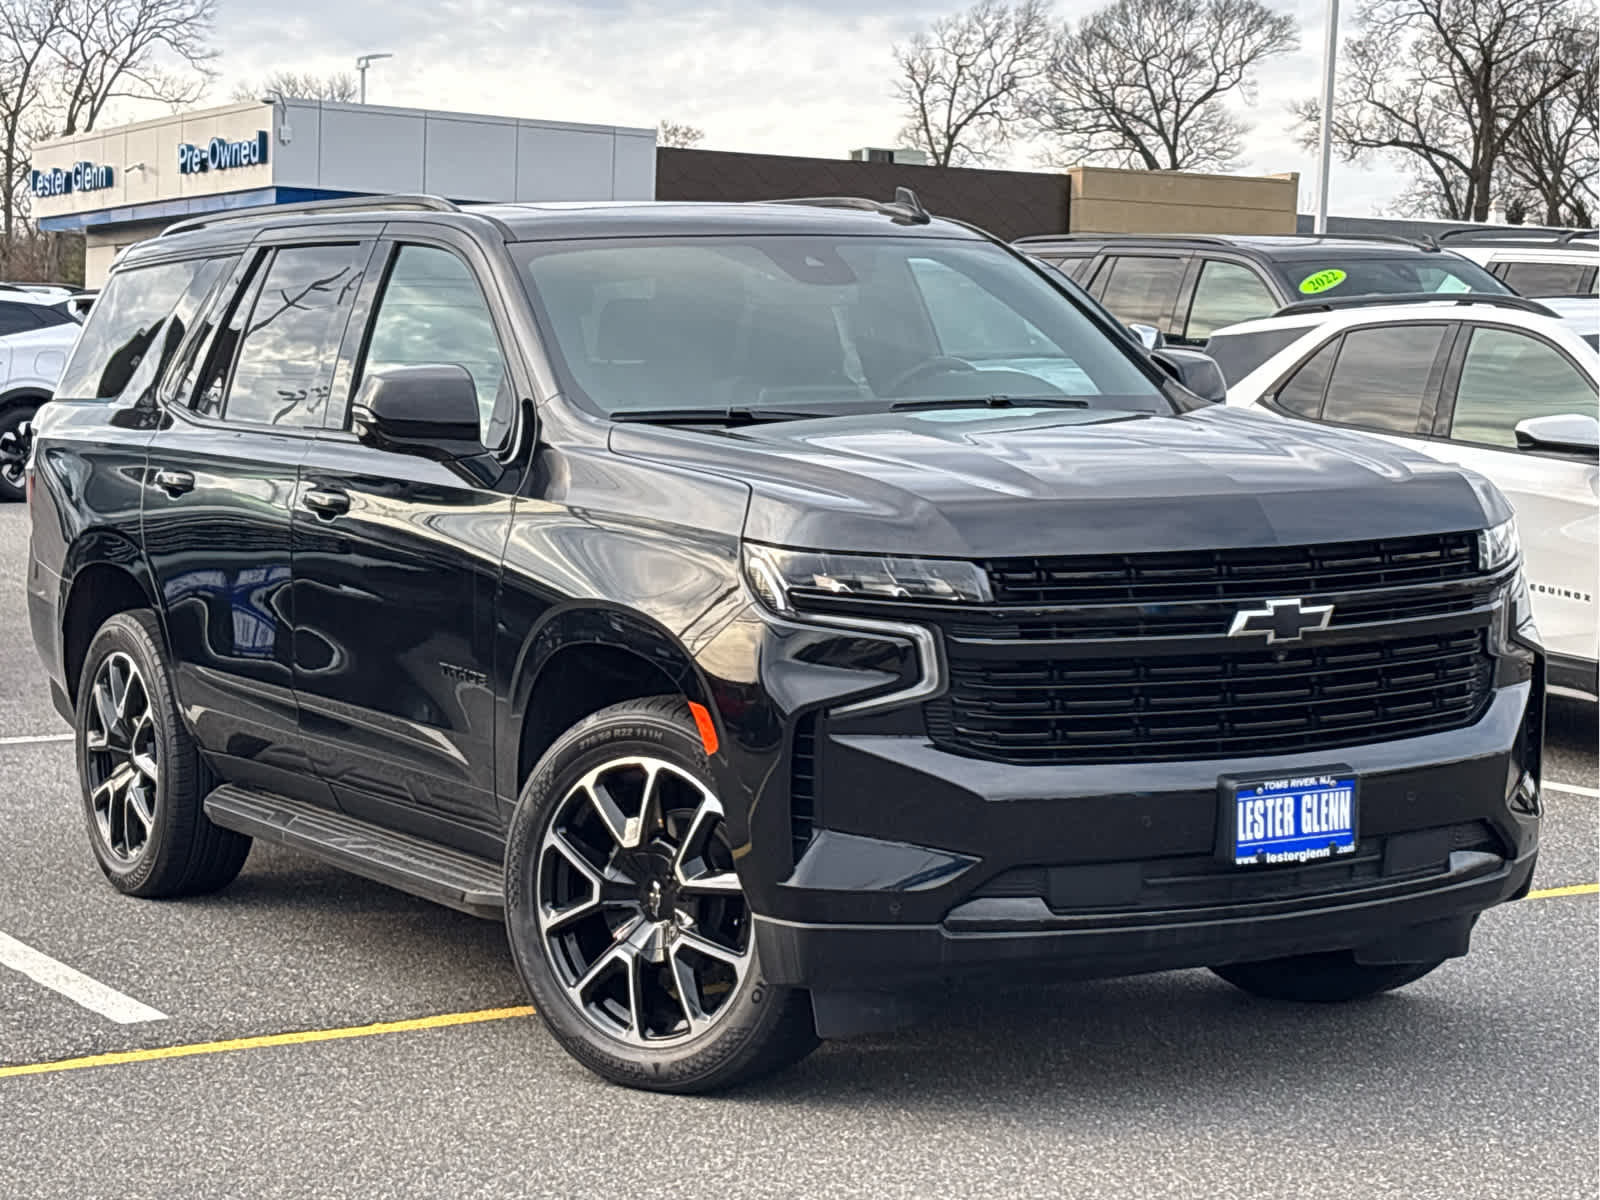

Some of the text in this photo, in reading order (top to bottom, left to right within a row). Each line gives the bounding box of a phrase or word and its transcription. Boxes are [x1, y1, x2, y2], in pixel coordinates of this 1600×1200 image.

[178, 130, 265, 174] Pre-Owned
[30, 162, 110, 197] Lester Glenn
[1308, 271, 1339, 291] 2022
[1529, 583, 1592, 602] EQUINOX
[1263, 780, 1289, 791] TOMS
[1237, 790, 1351, 842] LESTER GLENN
